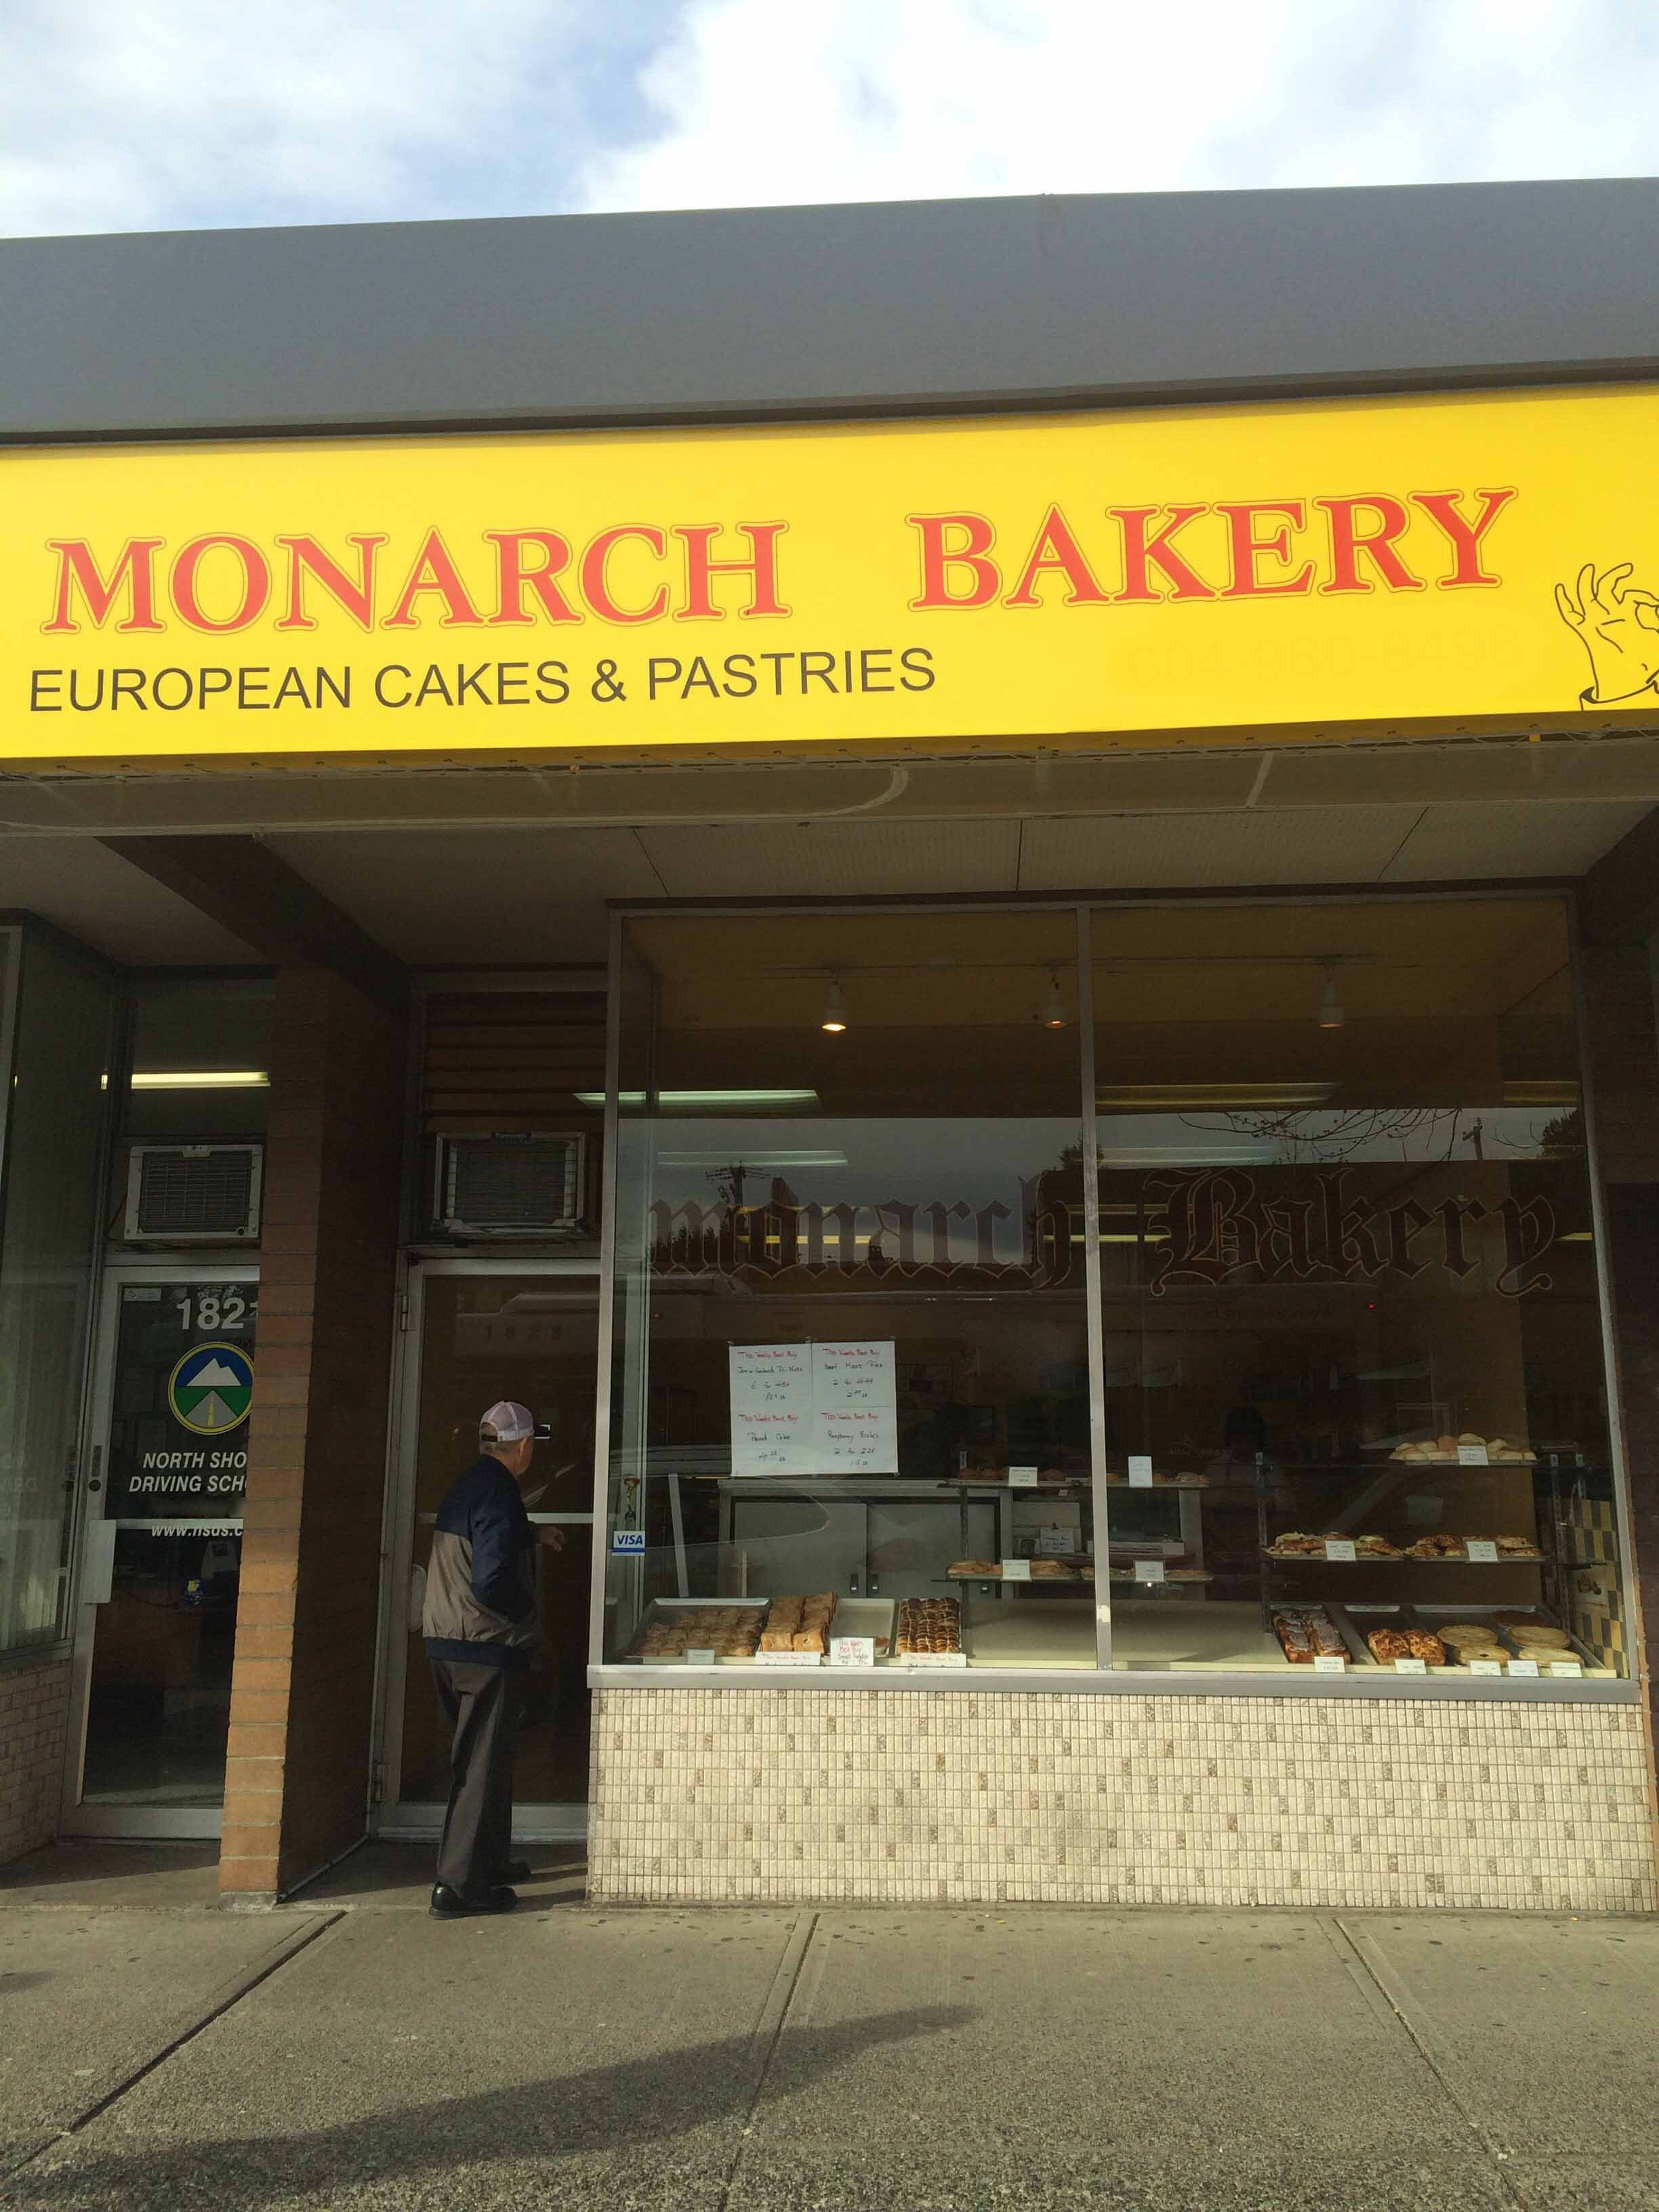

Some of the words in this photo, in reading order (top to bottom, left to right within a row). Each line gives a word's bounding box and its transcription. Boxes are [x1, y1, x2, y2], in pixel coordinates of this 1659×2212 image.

[40, 520, 793, 636] MONARCH
[905, 486, 1519, 612] BAKERY
[30, 666, 350, 712] EUROPEAN
[375, 661, 570, 708] CAKES
[591, 659, 627, 703] &
[649, 647, 935, 700] PASTRIES
[142, 1452, 205, 1469] NORTH
[129, 1475, 202, 1493] DRIVING
[207, 1475, 247, 1493] SCH
[617, 1534, 643, 1545] VISA
